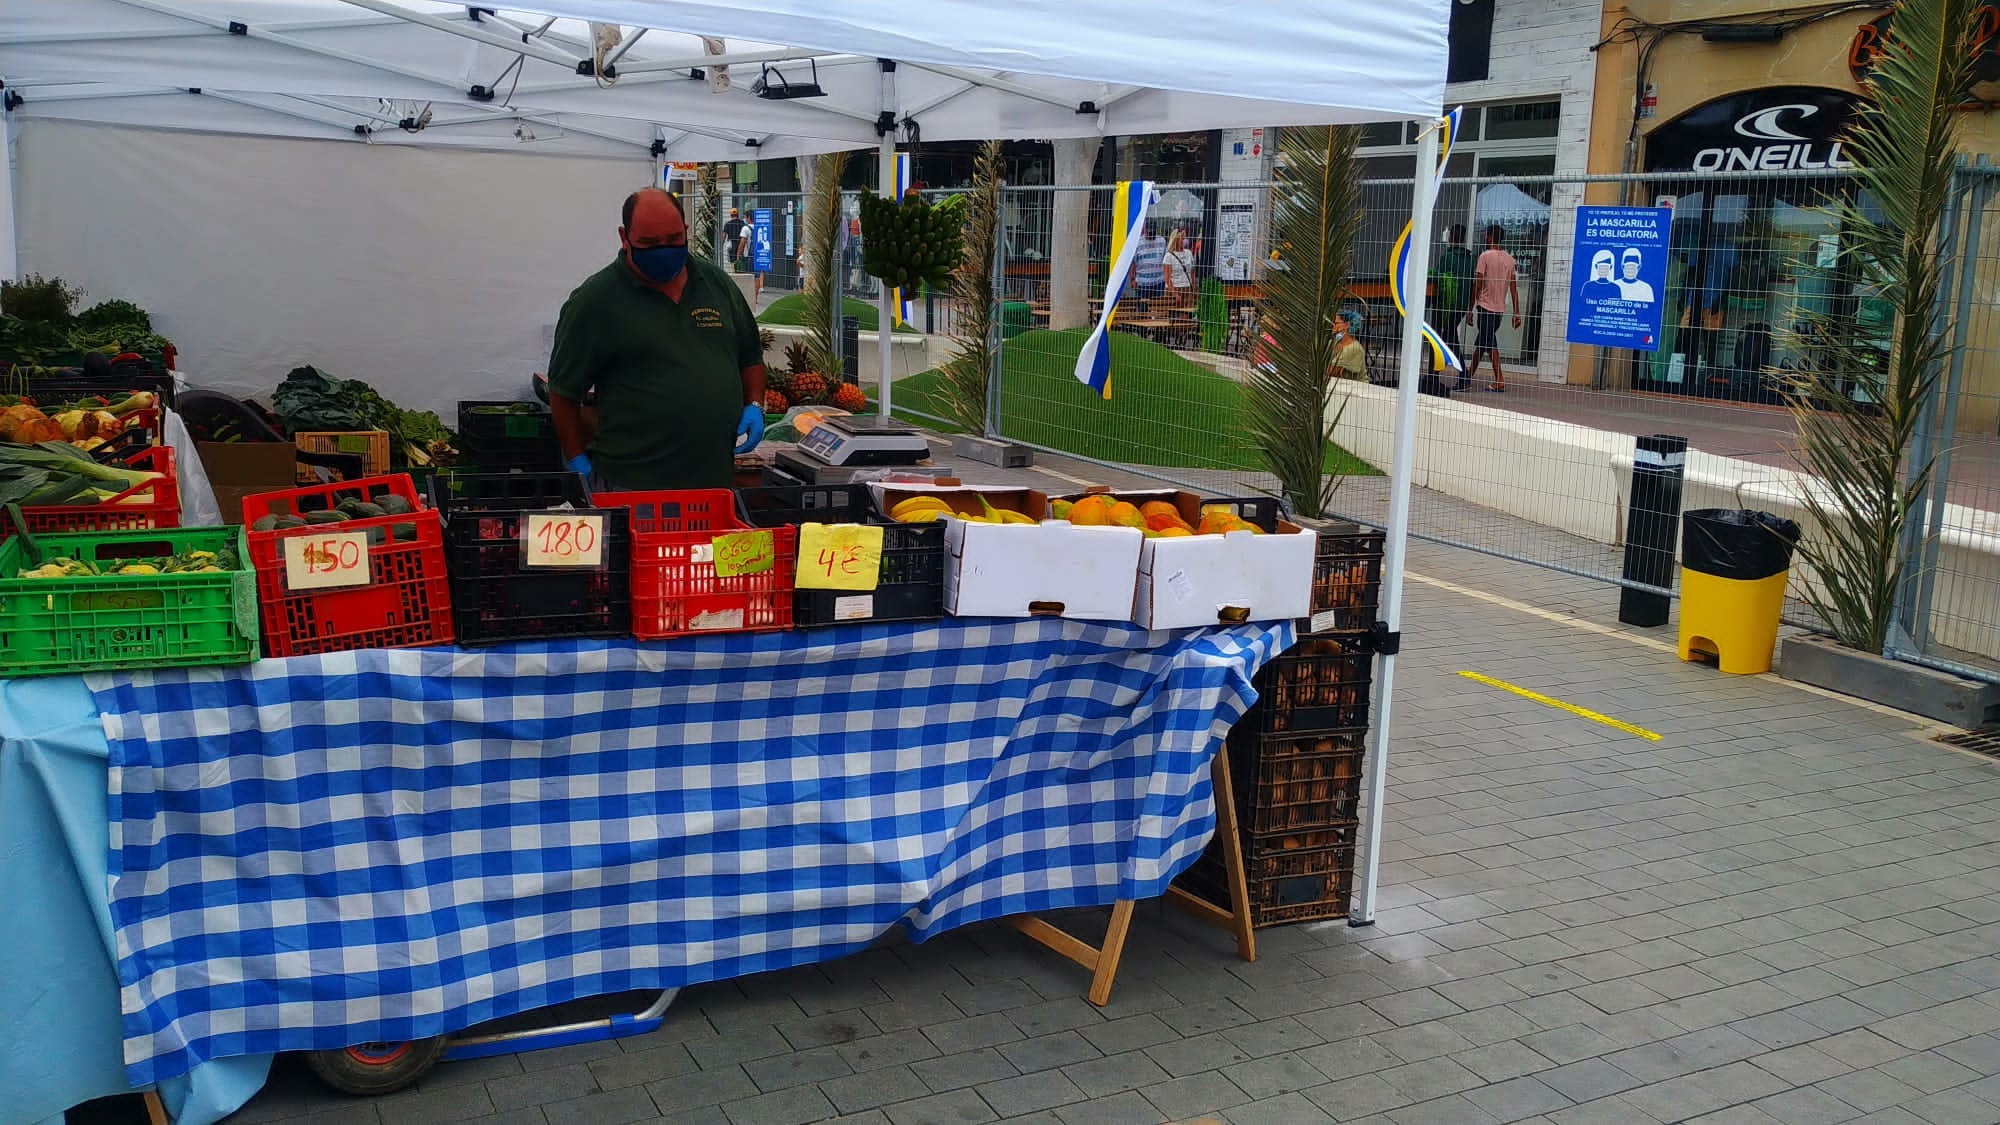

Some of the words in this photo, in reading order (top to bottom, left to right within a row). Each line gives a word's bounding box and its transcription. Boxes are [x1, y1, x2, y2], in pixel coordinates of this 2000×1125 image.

[1692, 143, 1855, 172] O'NEILL
[1587, 218, 1598, 226] LA
[1600, 218, 1657, 228] MASCARILLA
[1586, 228, 1598, 237] ES
[1599, 229, 1658, 239] OBLIGATORIA
[1598, 299, 1632, 307] CORRECTO
[1596, 306, 1636, 315] MASCARILLA
